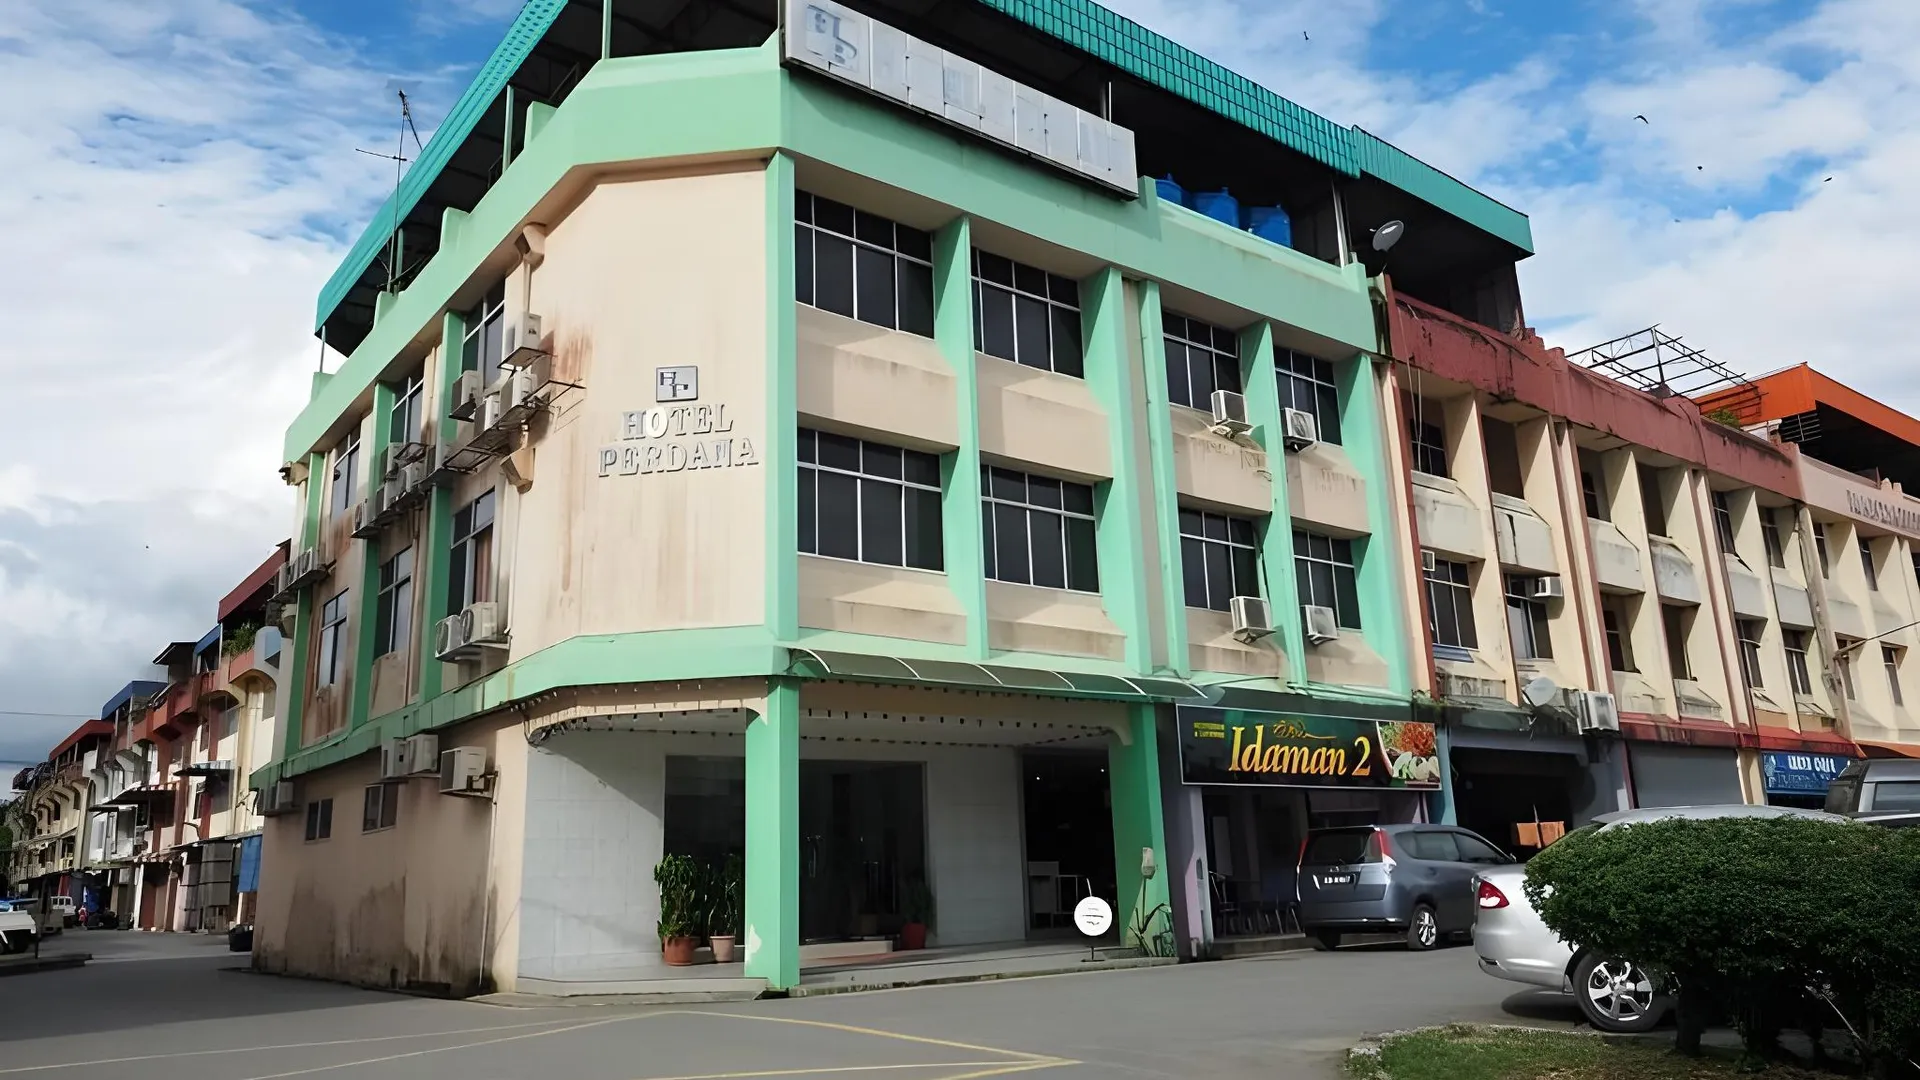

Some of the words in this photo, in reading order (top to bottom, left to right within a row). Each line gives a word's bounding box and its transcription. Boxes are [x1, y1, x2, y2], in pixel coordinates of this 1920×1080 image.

[622, 404, 734, 441] HOTEL
[598, 438, 759, 478] PERDANA
[1228, 724, 1348, 776] Idaman
[1351, 736, 1371, 776] 2
